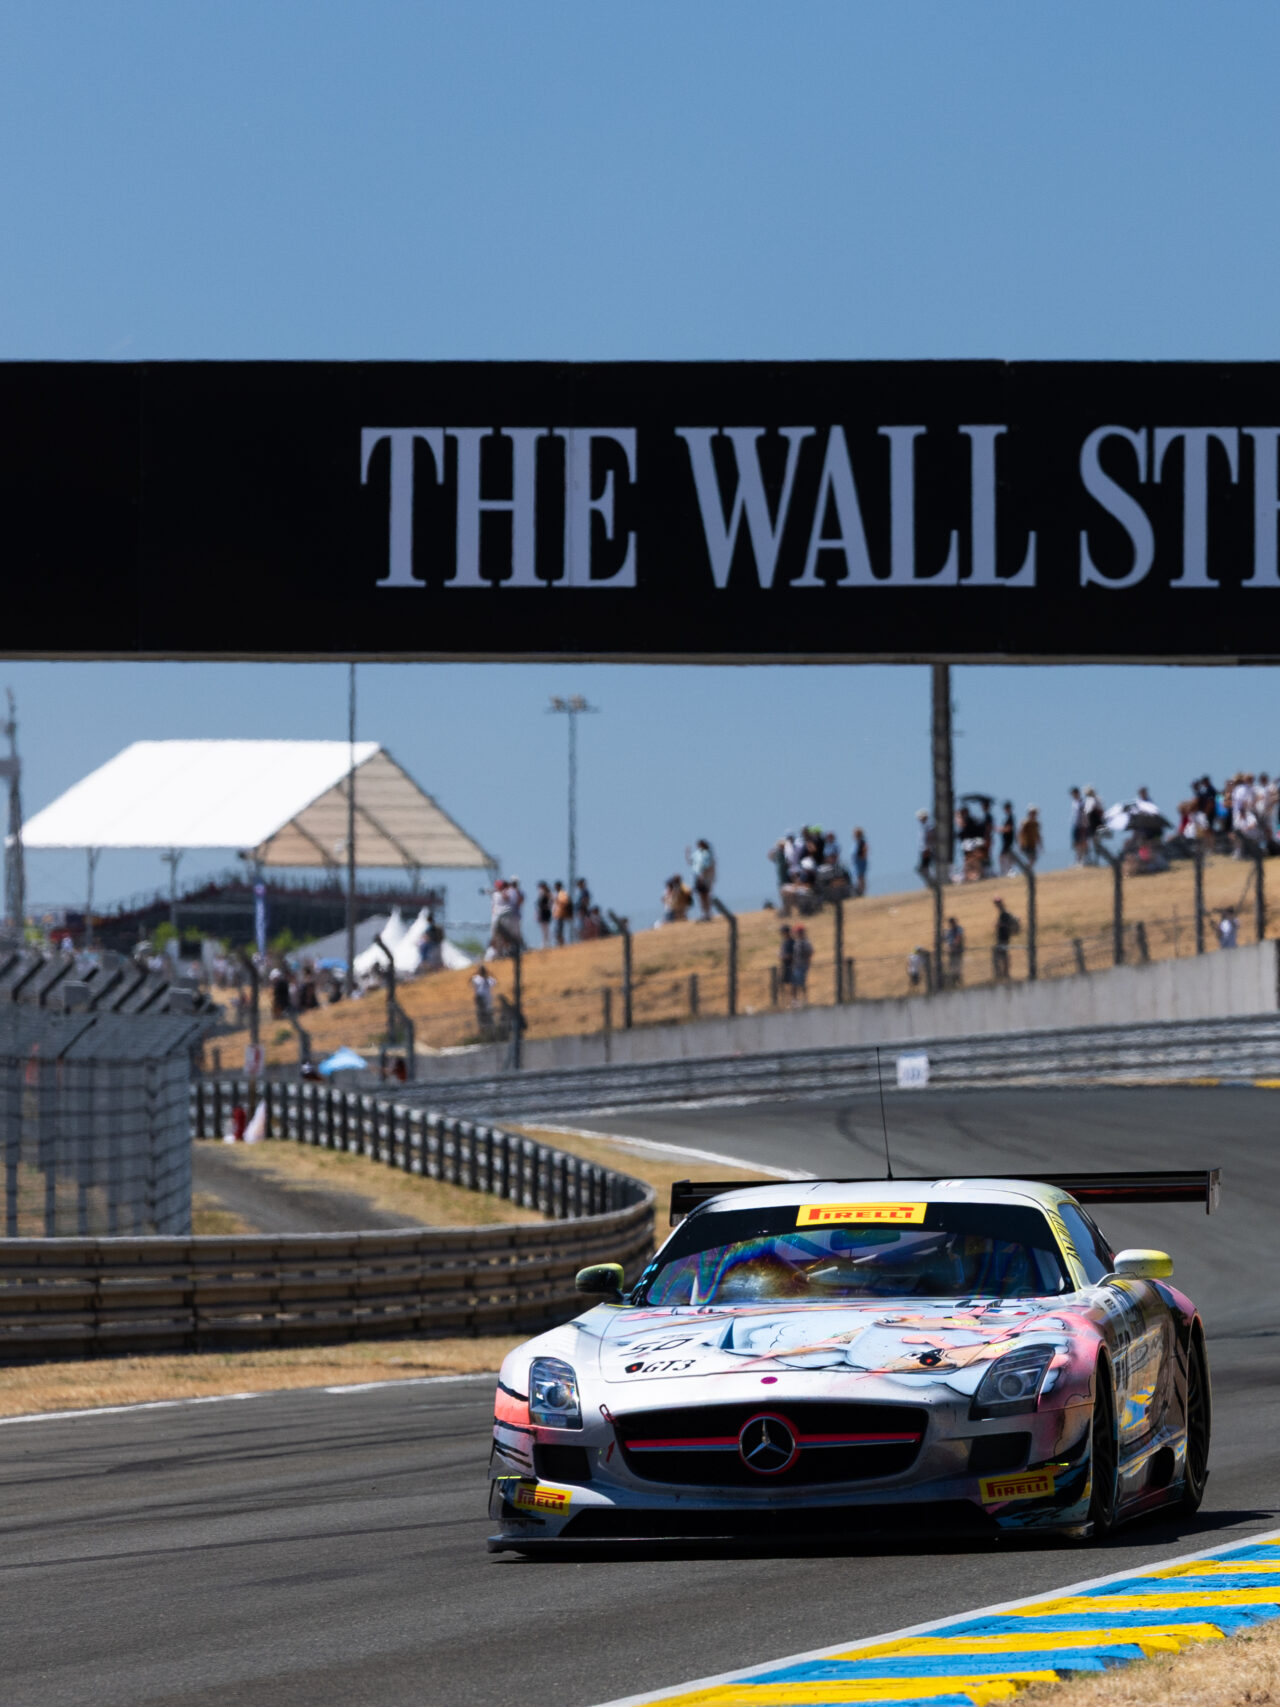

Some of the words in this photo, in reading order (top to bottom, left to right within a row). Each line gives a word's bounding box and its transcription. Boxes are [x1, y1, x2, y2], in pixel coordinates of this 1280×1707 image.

[362, 428, 636, 587] THE
[676, 426, 1035, 588] WALL
[808, 1206, 915, 1221] PIRELLI
[618, 1337, 695, 1357] 50
[641, 1359, 697, 1373] GT3
[986, 1475, 1048, 1498] PIRELLI
[517, 1487, 566, 1510] PIRELLI
